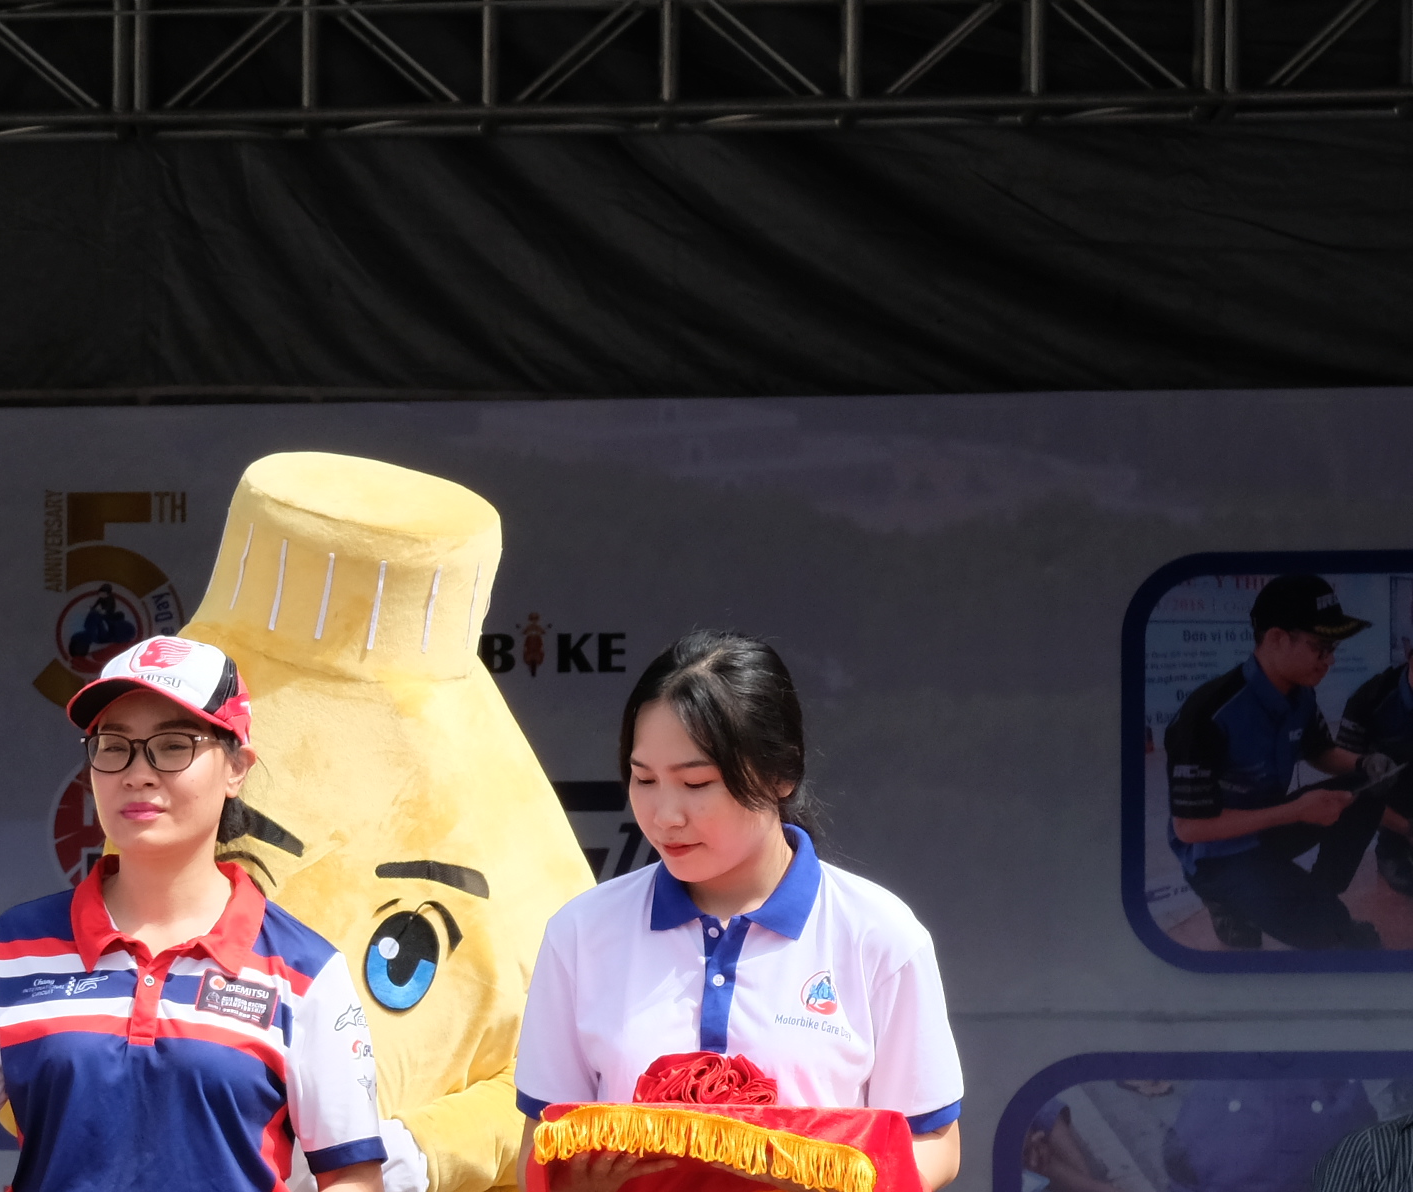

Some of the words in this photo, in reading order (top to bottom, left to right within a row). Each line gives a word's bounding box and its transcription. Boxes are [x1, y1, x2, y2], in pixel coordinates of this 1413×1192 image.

[43, 490, 63, 593] ANNIVERSARY
[225, 983, 270, 999] IDEMITSU
[774, 1014, 819, 1030] Motorbike
[821, 1020, 840, 1035] Care
